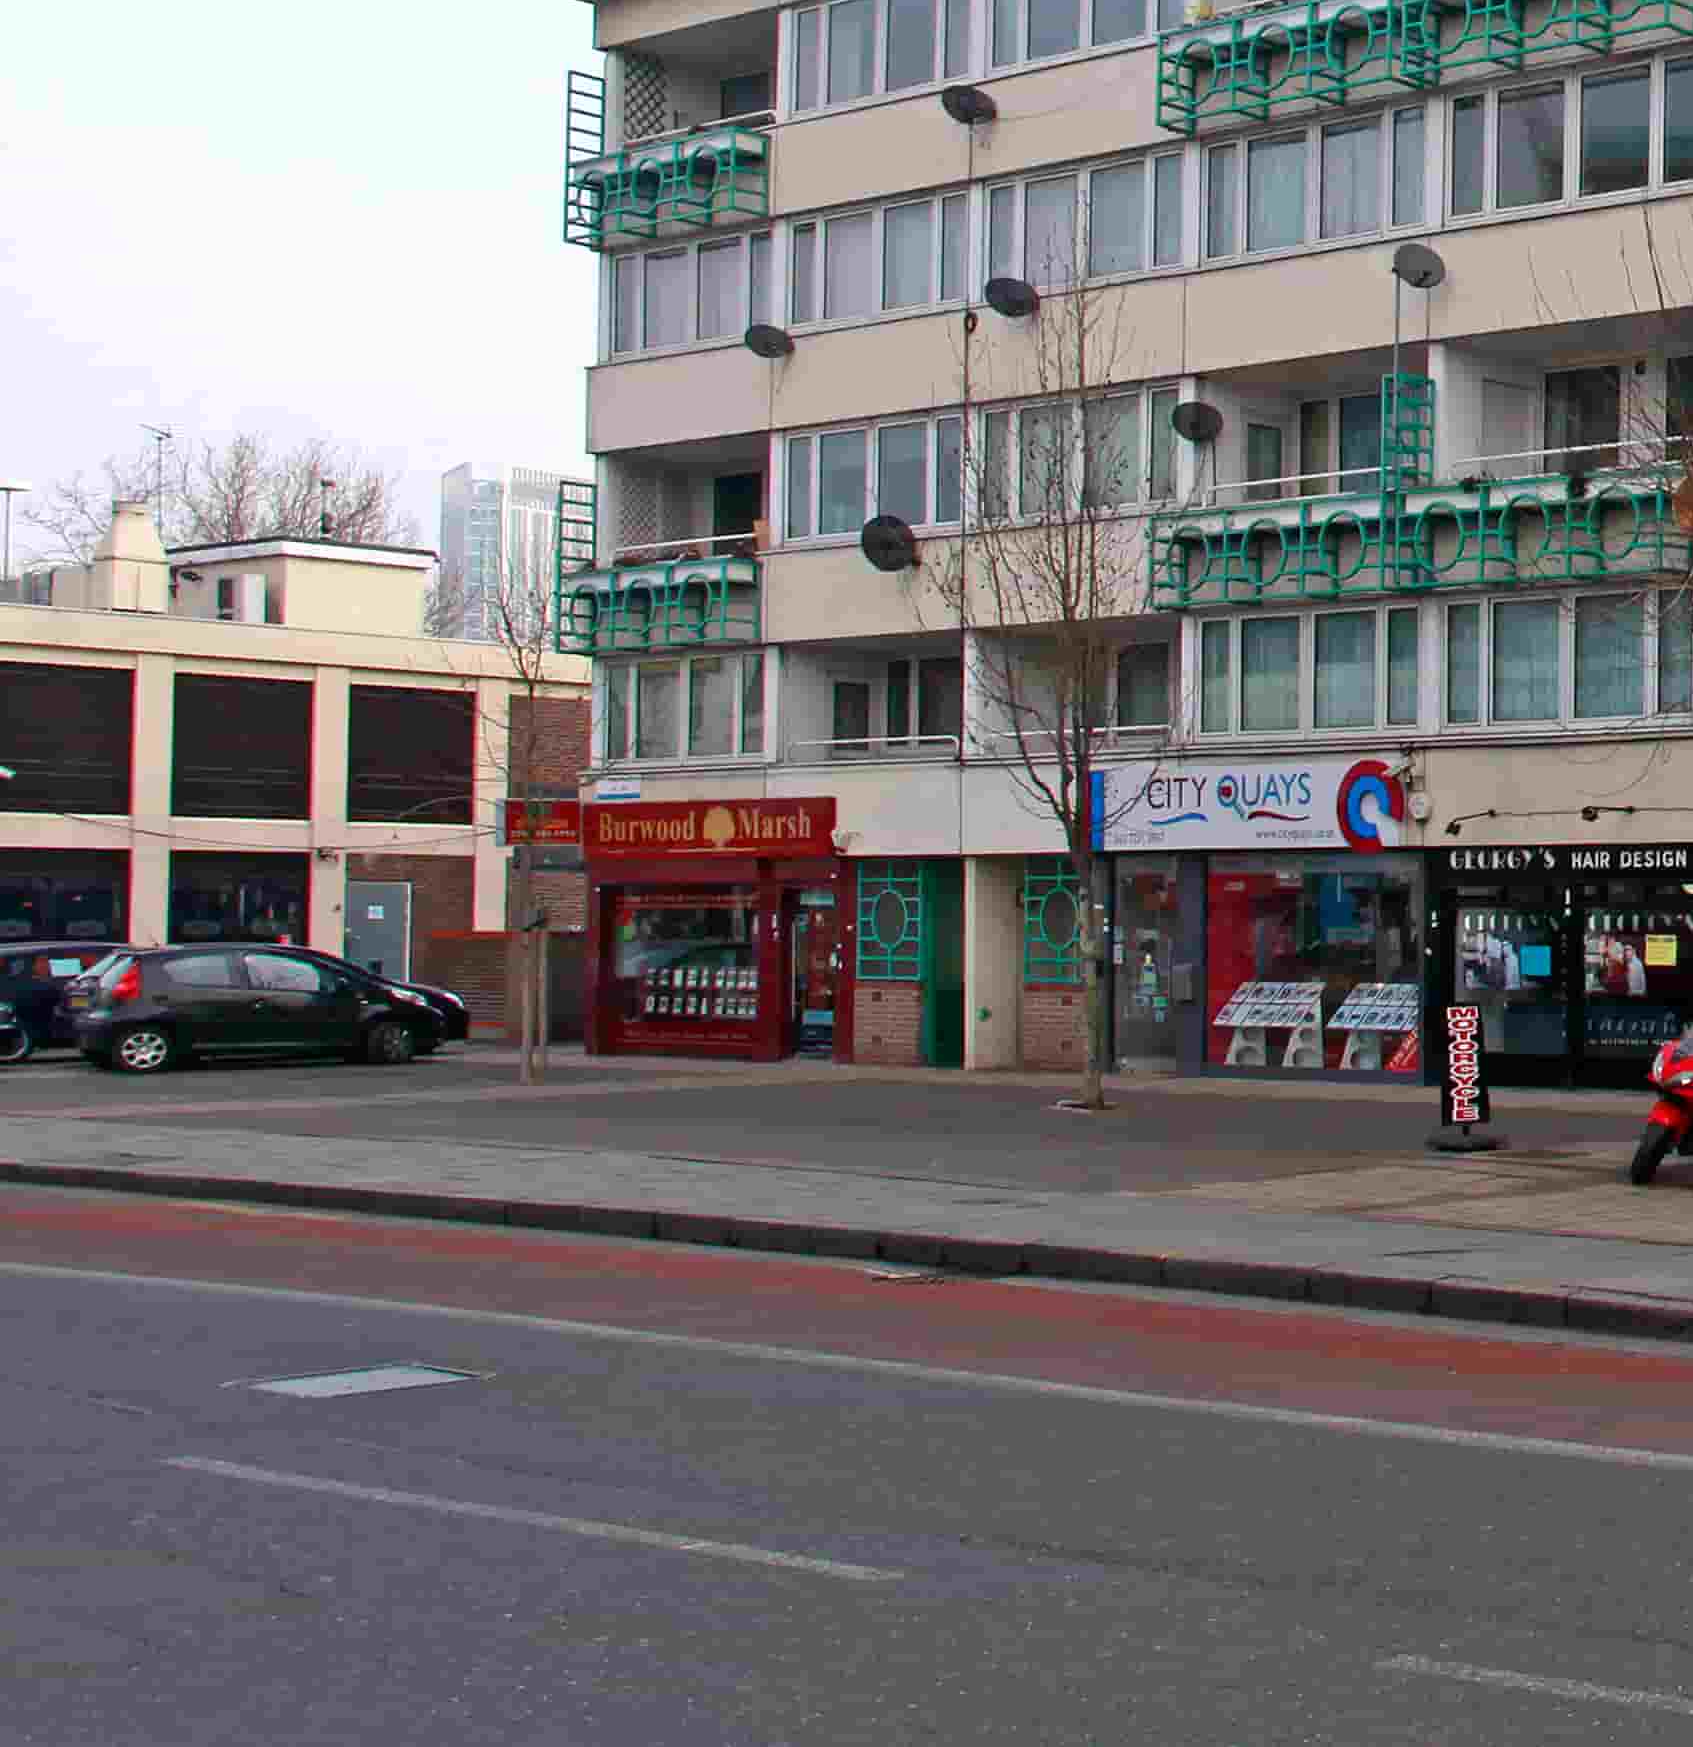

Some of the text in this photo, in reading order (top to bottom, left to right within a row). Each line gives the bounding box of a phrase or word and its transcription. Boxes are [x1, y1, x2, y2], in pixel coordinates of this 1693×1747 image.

[1148, 773, 1312, 821] CITY QUAYS
[599, 810, 695, 843] Burwood
[737, 805, 812, 840] Marsh
[1450, 848, 1556, 870] GEORGY'S
[1571, 851, 1611, 869] HAIR
[1619, 849, 1688, 868] DESIGN
